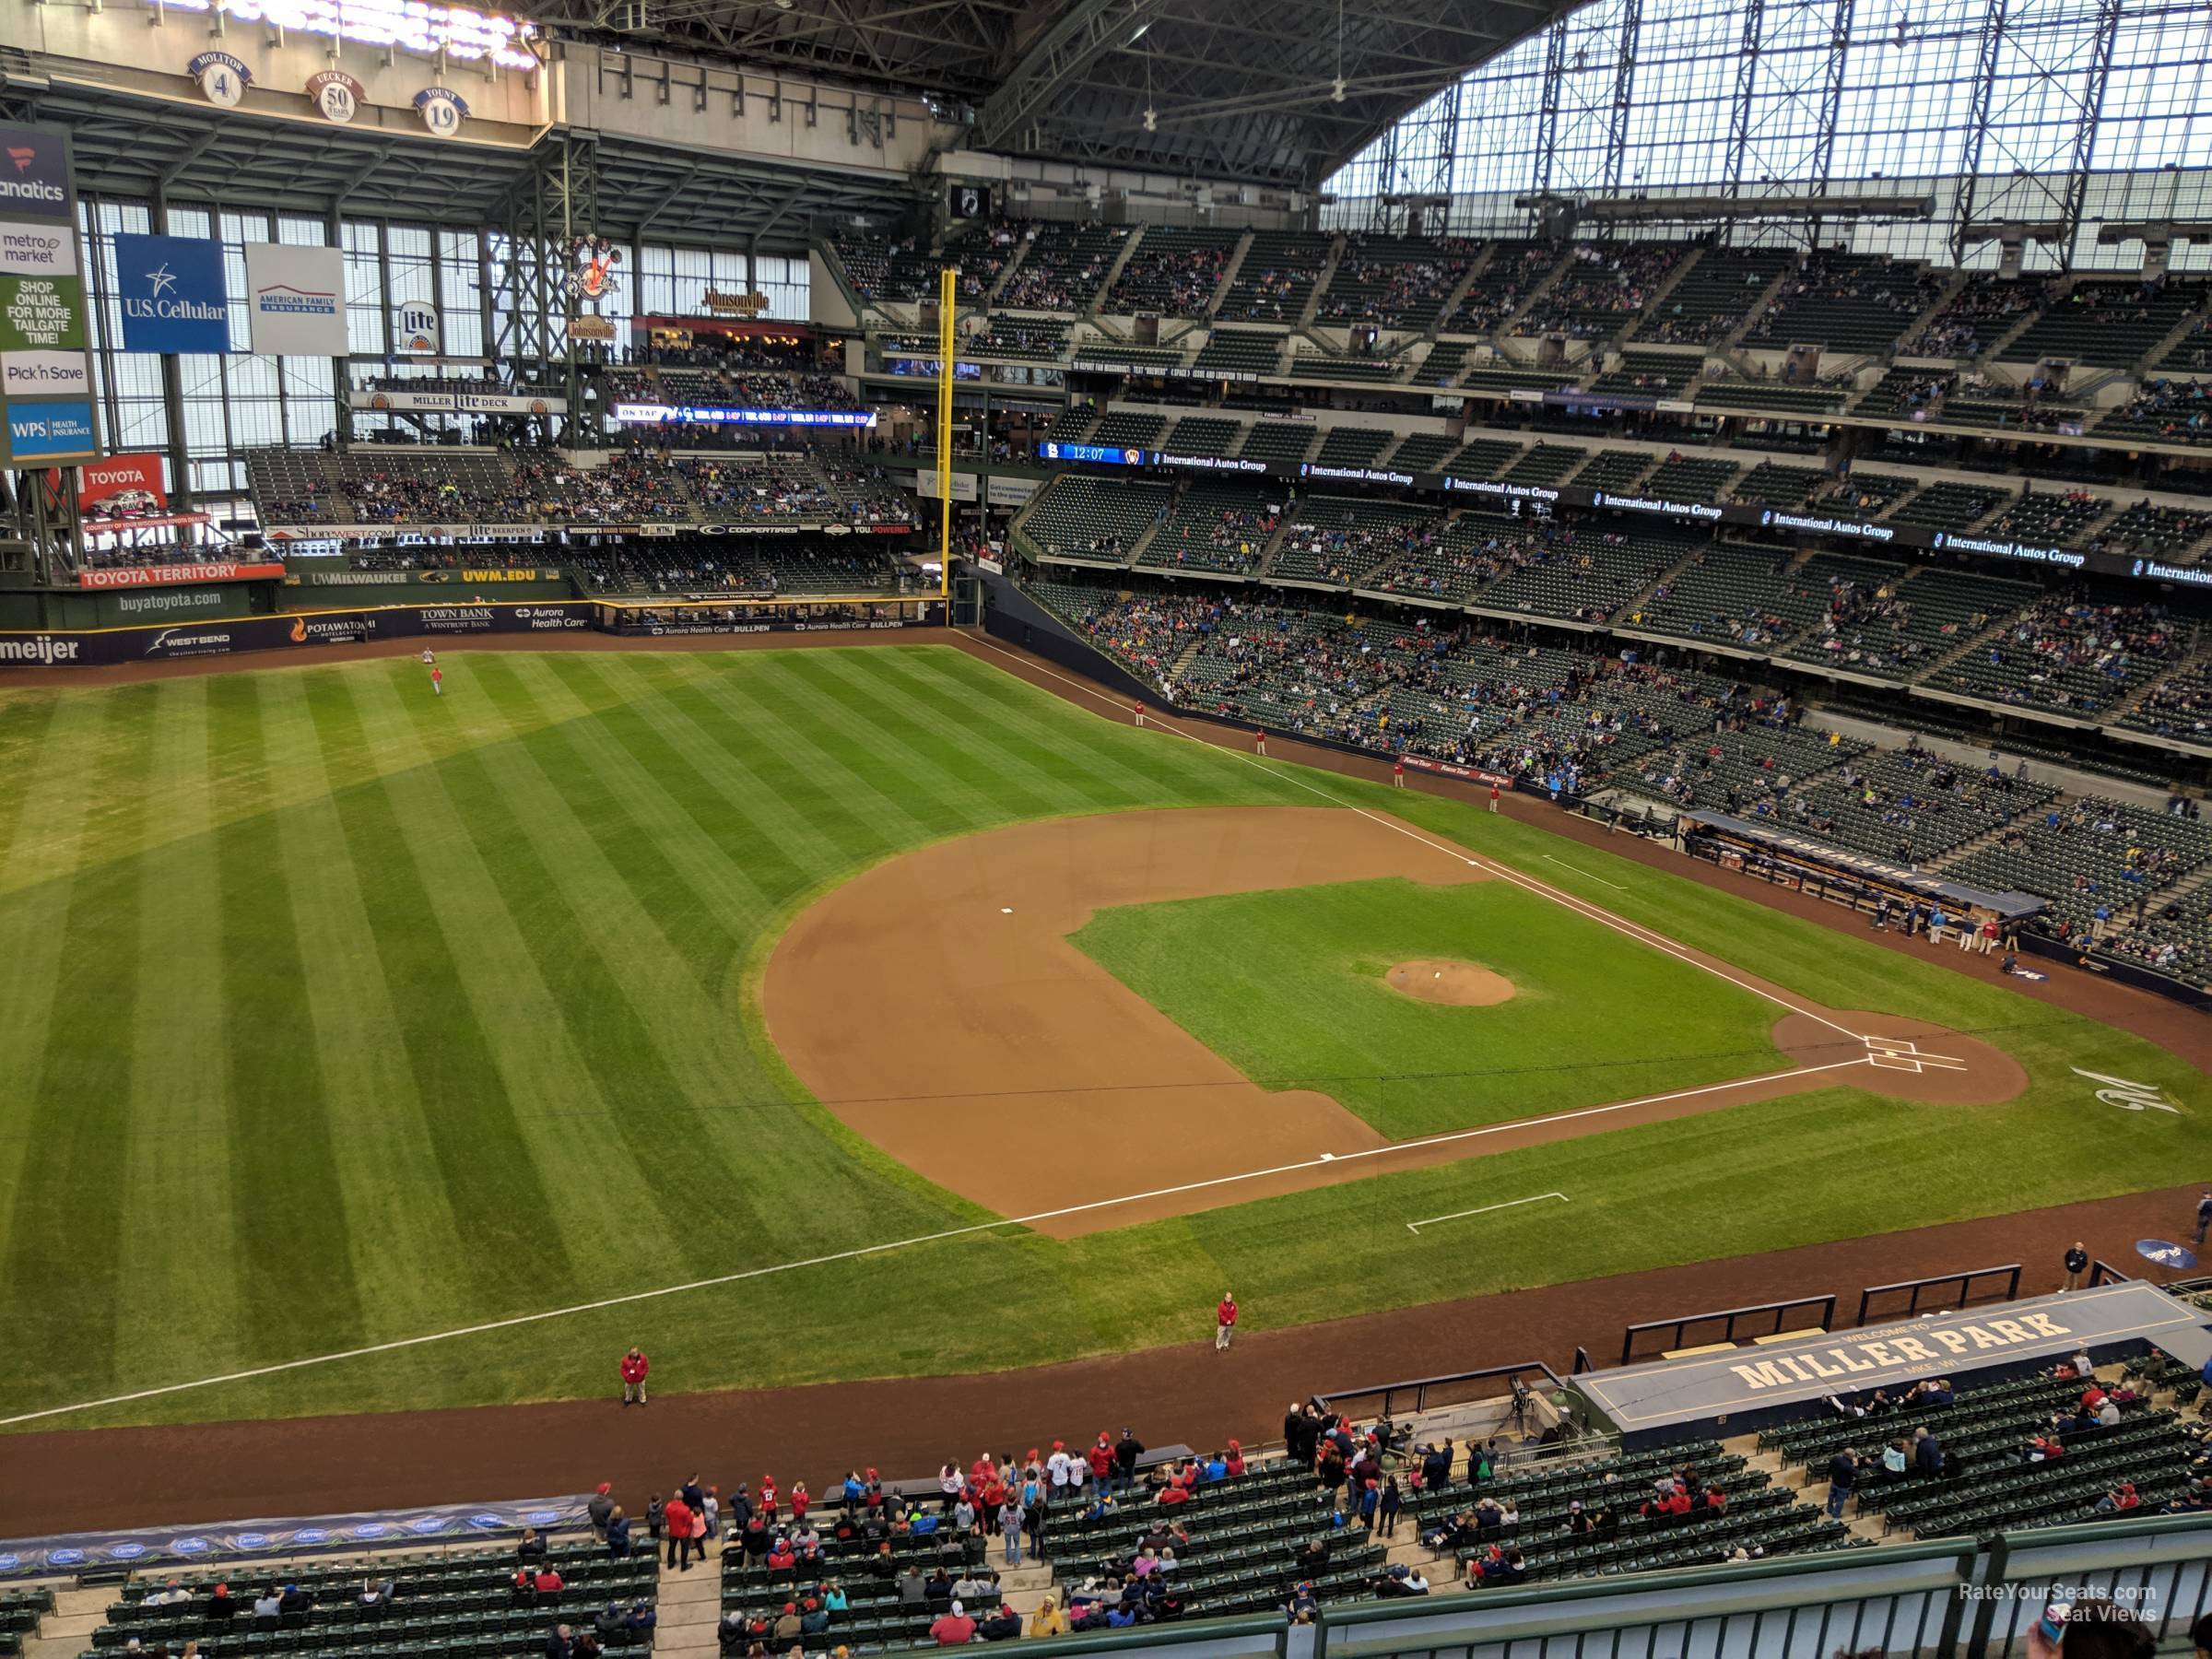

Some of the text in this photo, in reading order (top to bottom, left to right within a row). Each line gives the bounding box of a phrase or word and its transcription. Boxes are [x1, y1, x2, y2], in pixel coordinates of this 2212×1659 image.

[197, 53, 243, 73] MOLITOR
[214, 73, 229, 97] 4
[316, 72, 353, 87] UECKER
[326, 87, 348, 108] 50
[426, 88, 457, 101] YOUNT
[431, 108, 454, 128] 19
[4, 234, 45, 248] metro
[6, 250, 54, 264] market
[19, 280, 54, 294] SHOP
[16, 293, 61, 307] ONLINE
[260, 295, 335, 306] AMERICAN FAMILY
[701, 287, 770, 311] Johnsonville
[7, 305, 72, 320] FOR MORE
[124, 298, 226, 321] U.S. Cellular
[265, 305, 331, 313] INSURANCE
[13, 319, 69, 332] TAILGATE
[404, 311, 434, 334] Lite
[570, 324, 615, 338] Johnsonville
[26, 332, 59, 345] TIME!
[51, 366, 83, 380] Save
[413, 394, 509, 410] MILLER Lite DECK
[13, 421, 46, 439] WPS
[52, 420, 77, 429] HEALTH
[53, 427, 90, 436] INSURANCE
[1073, 447, 1105, 460] 12:07
[1163, 453, 1266, 472] International Autos Group
[88, 470, 146, 486] TOYOTA
[1311, 465, 1414, 486] International Autos Group
[1453, 477, 1559, 500] International Autos Group
[122, 500, 144, 511] RAV4
[1604, 494, 1723, 519] International Autos Group
[86, 524, 114, 532] COURTESY
[1773, 512, 1894, 540] International Autos Group
[1946, 535, 2085, 567] International Autos Group
[84, 564, 238, 585] TOYOTA TERRITORY
[463, 570, 536, 582] UWM.EDU
[120, 592, 221, 612] buyatoyota.com
[420, 607, 494, 619] TOWN BANK
[533, 608, 564, 618] Aurora
[532, 618, 585, 629] Health Care
[665, 625, 771, 635] Aurora Health Care BULLPEN
[166, 634, 230, 647] WEST BEND
[0, 635, 78, 664] meijer
[1841, 1323, 1930, 1343] WELCOME TO
[1729, 1312, 2073, 1390] MILLER PARK
[1939, 1358, 1960, 1368] WI
[237, 1535, 265, 1545] Carrier
[298, 1531, 324, 1540] Carrier
[114, 1547, 142, 1555] Carrier
[177, 1541, 206, 1550] Carrier
[52, 1552, 79, 1561] Carrier
